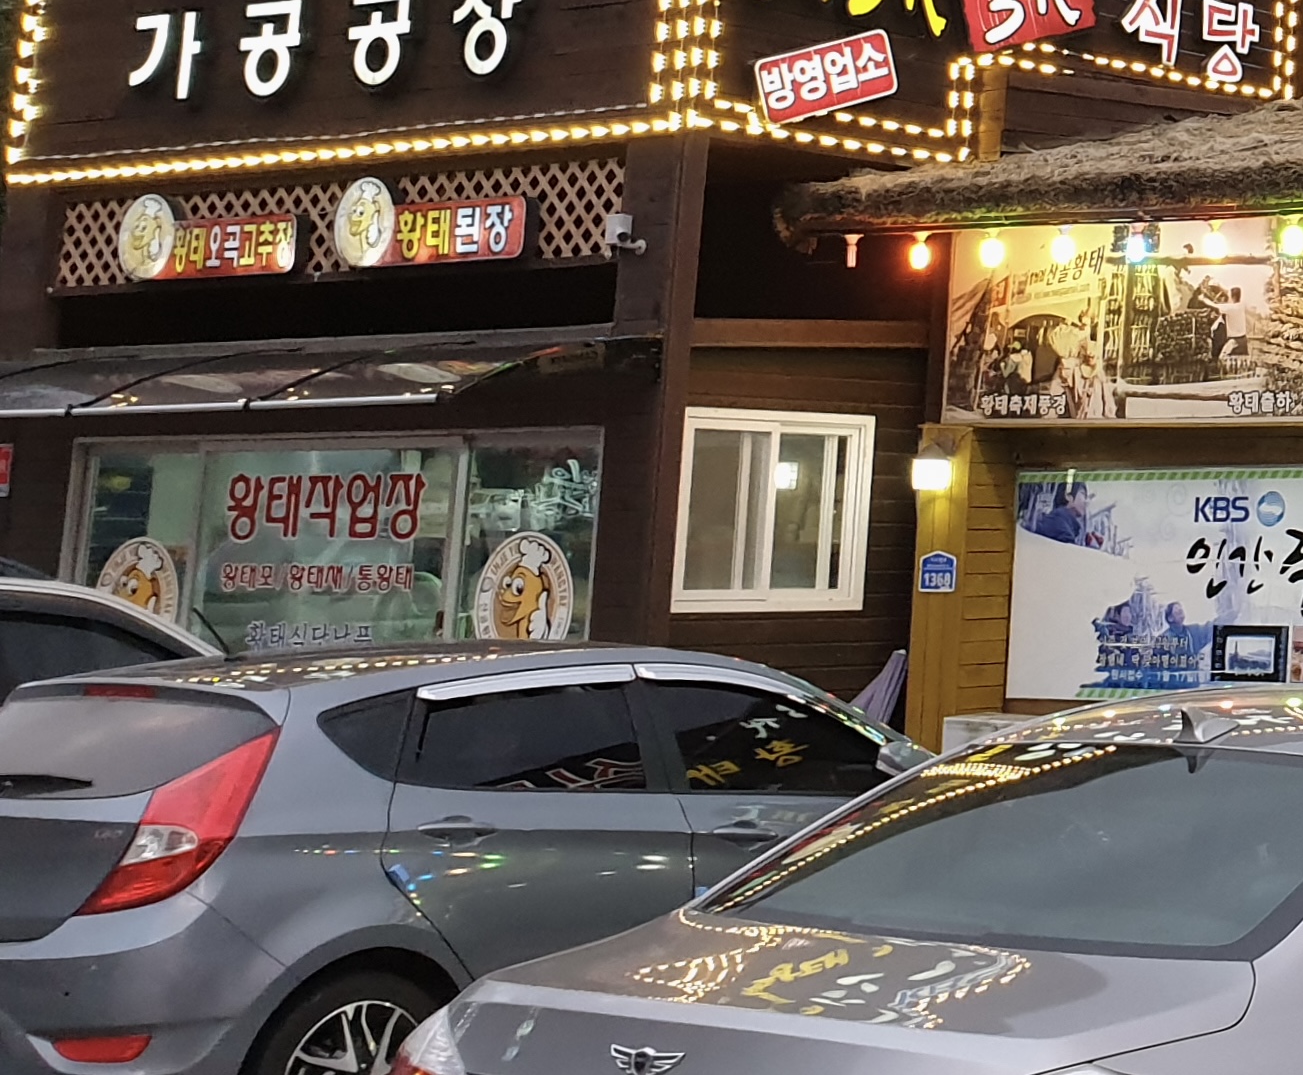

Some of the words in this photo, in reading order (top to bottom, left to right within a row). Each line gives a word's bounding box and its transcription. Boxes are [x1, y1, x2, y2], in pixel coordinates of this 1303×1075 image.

[760, 46, 890, 111] 방영업소
[396, 203, 514, 258] 황태된장
[980, 392, 1067, 417] 황태축제풍경
[1227, 390, 1294, 414] 황태출하
[226, 472, 427, 541] 황태작업장
[1194, 496, 1250, 522] KBS
